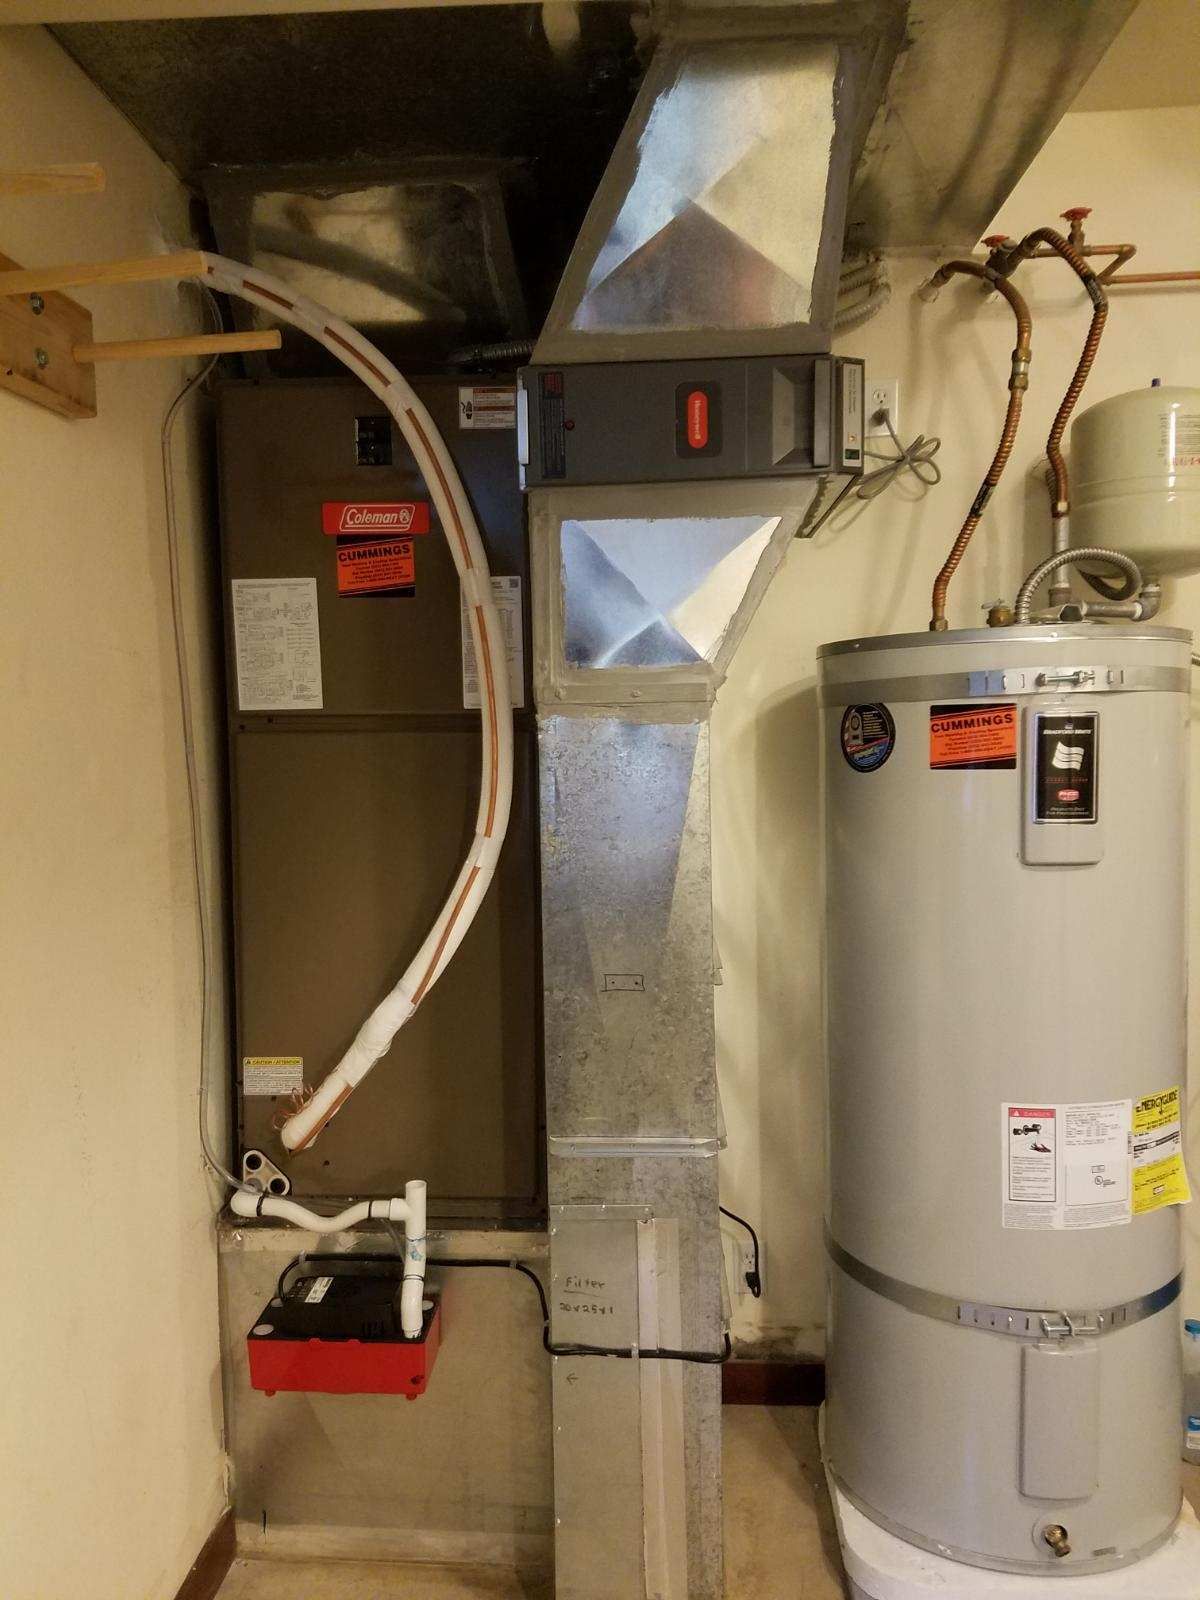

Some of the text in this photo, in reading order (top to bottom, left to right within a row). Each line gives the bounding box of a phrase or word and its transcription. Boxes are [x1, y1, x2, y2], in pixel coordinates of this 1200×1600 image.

[346, 508, 398, 525] Coleman
[338, 544, 410, 562] CUMMINGS
[931, 713, 1013, 733] CUMMINGS
[566, 1275, 606, 1290] Filter
